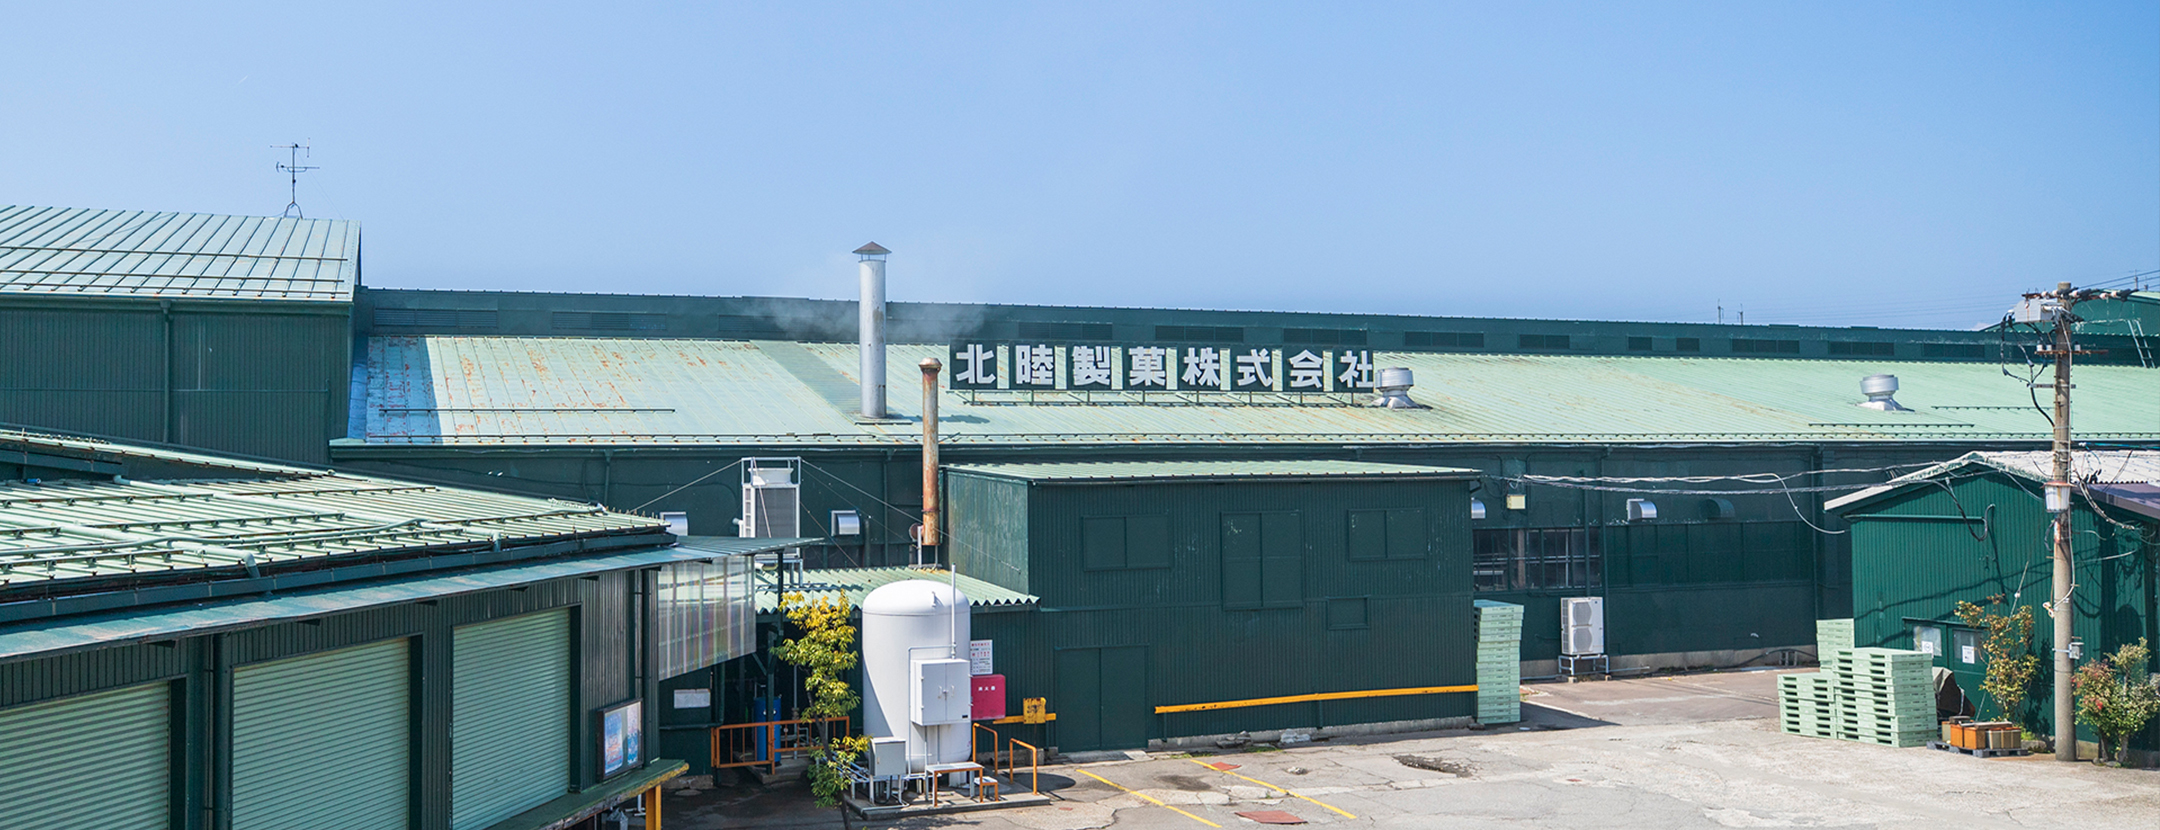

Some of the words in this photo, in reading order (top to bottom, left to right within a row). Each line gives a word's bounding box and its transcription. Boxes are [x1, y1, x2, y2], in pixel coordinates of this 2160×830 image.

[956, 344, 1373, 389] 北陸製菓株式会社
